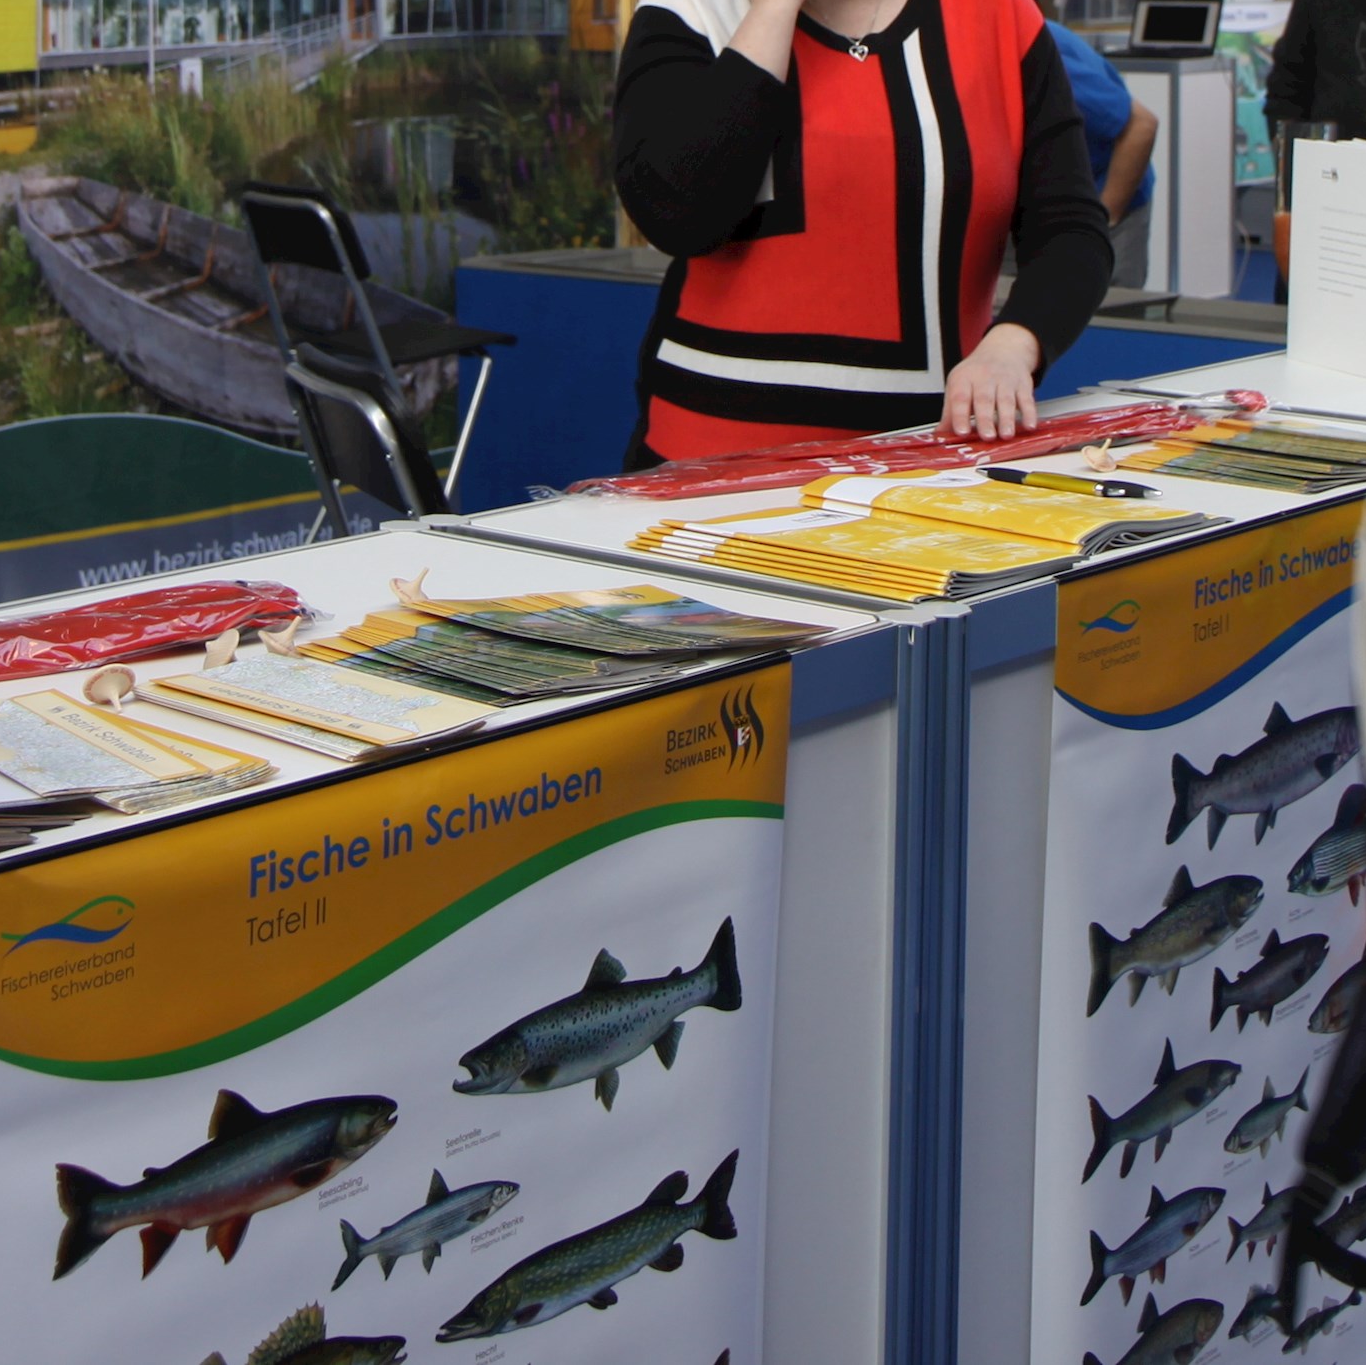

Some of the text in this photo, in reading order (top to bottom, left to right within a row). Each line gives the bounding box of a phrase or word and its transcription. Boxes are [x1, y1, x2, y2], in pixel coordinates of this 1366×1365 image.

[1194, 536, 1362, 609] Fische in Schwabe
[1193, 614, 1223, 643] Tafel
[62, 711, 100, 738] Bezirk
[94, 722, 158, 764] Schwaben
[666, 721, 717, 753] BEZIRK
[664, 745, 726, 775] SCHWABEN
[249, 766, 602, 899] Fische in Schwaben
[246, 897, 327, 947] Tafel II
[1, 943, 135, 995] Fischereiverband
[50, 965, 135, 1002] Schwaben
[318, 1175, 363, 1201] Seesaibling
[475, 1344, 498, 1361] Hecht
